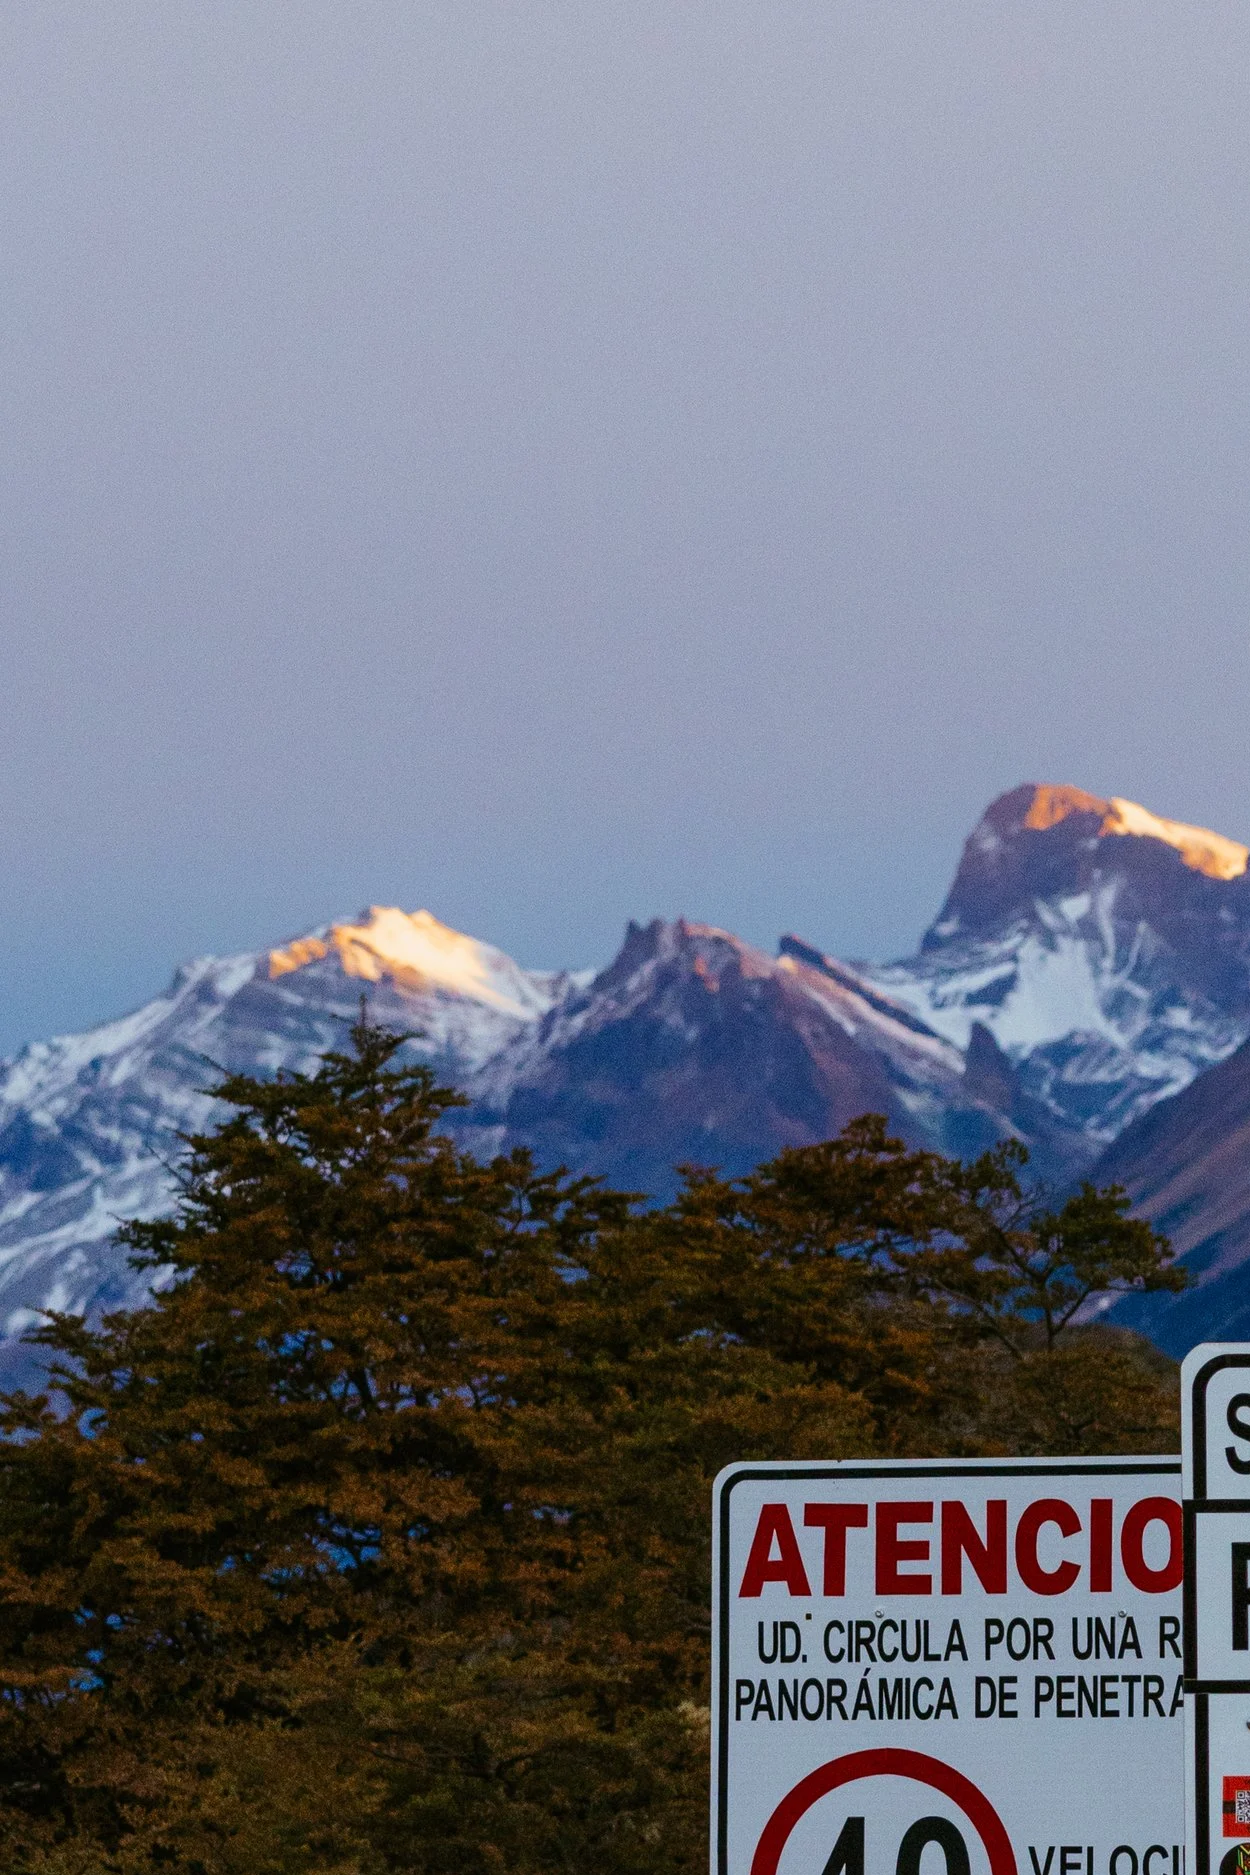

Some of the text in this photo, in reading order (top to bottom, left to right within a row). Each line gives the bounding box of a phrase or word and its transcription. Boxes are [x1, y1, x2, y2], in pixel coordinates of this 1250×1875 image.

[823, 1617, 969, 1664] CIRCULA
[984, 1616, 1056, 1662] POR
[1071, 1616, 1143, 1660] UNA
[735, 1668, 959, 1721] PANORÁMICA
[974, 1675, 1018, 1719] DE
